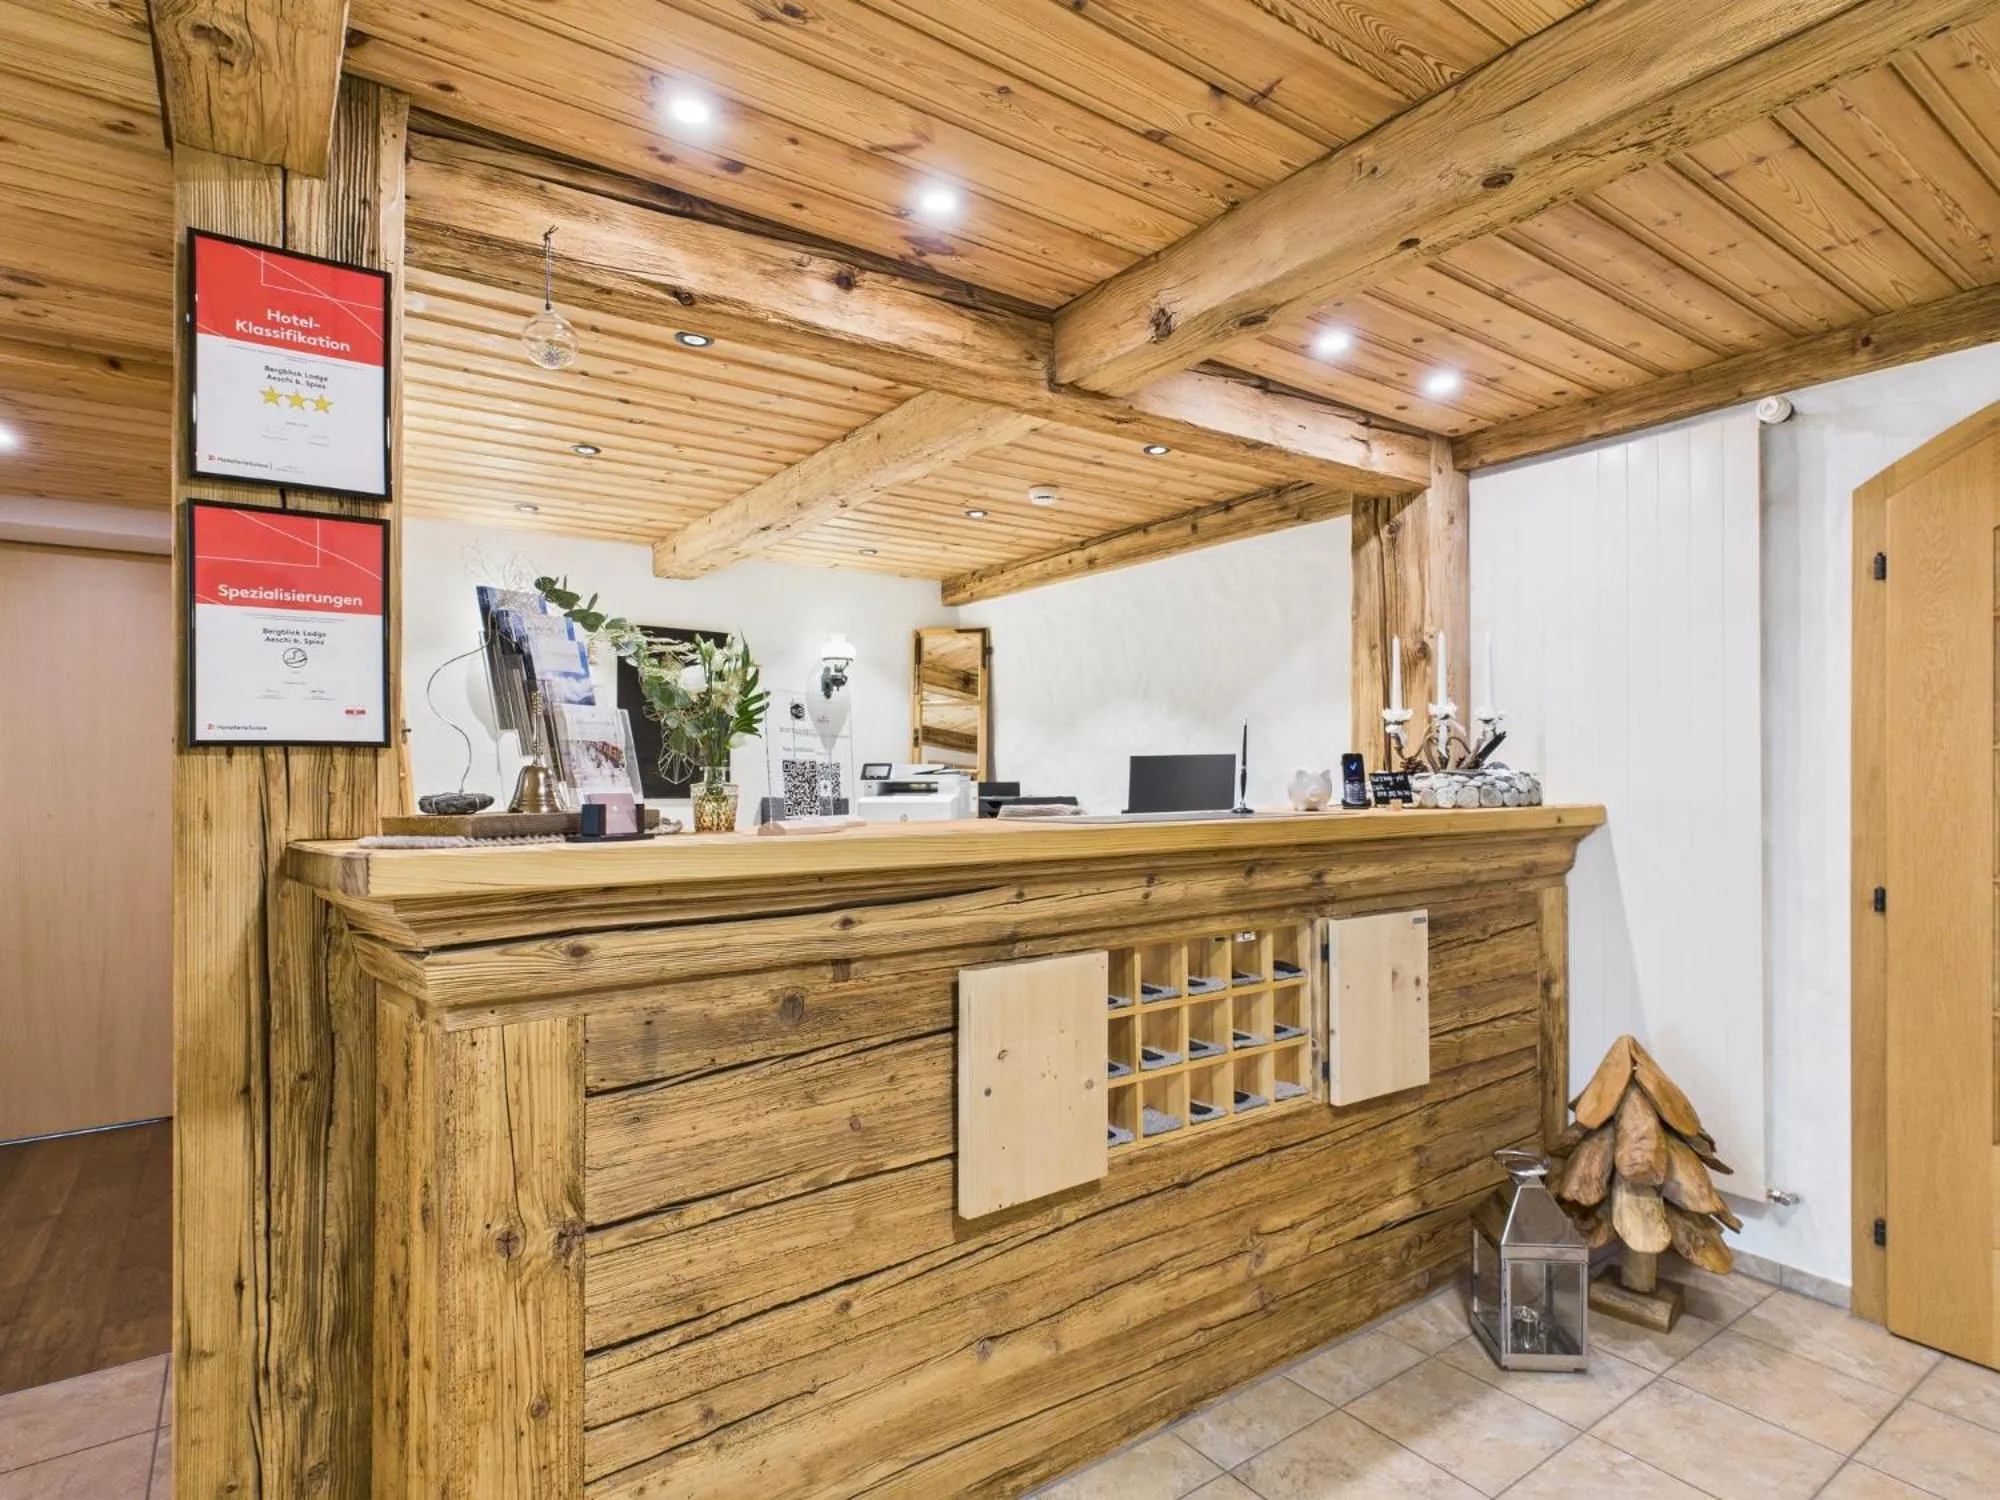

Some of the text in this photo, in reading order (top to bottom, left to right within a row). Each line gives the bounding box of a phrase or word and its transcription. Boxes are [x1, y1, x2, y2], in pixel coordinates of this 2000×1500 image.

[266, 308, 321, 329] Hotel-
[235, 319, 351, 352] Klassifikation
[217, 583, 363, 608] Spezialisierungen
